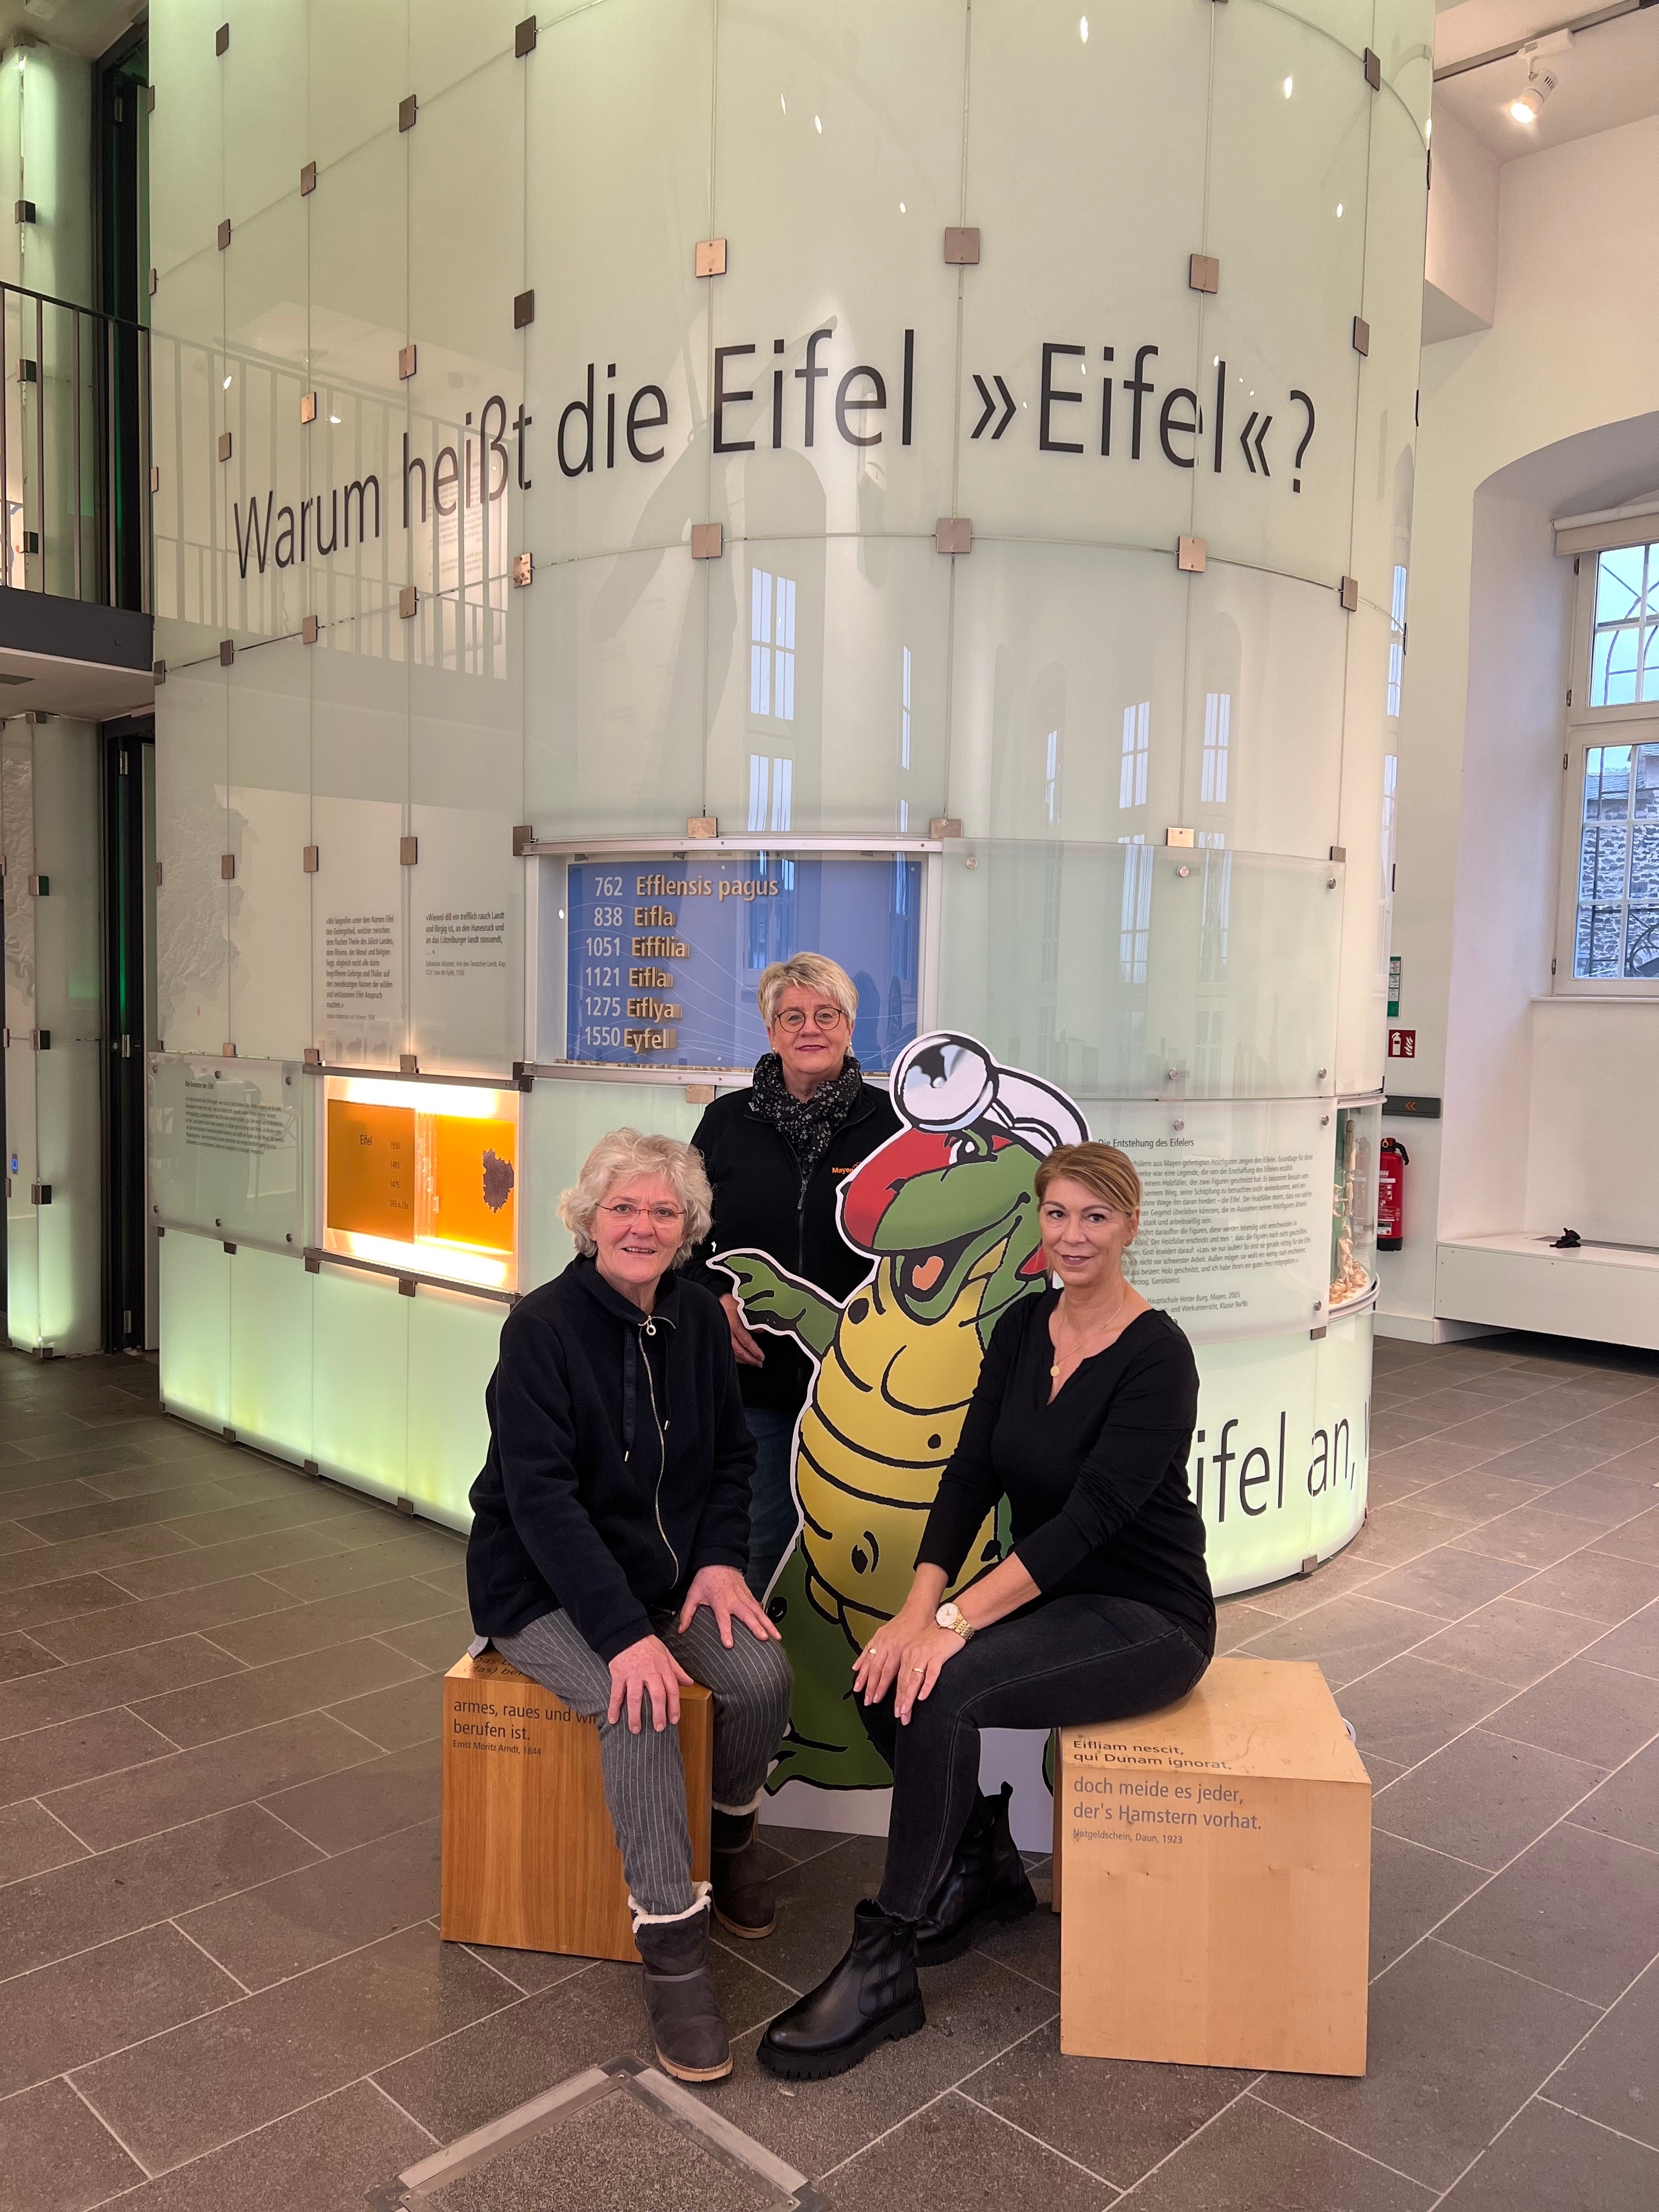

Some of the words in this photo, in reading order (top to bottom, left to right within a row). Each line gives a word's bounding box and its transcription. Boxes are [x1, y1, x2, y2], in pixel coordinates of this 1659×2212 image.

[234, 475, 379, 579] Warum
[403, 395, 532, 528] heißt
[557, 363, 668, 477] die
[713, 329, 914, 453] Eifel
[595, 876, 622, 896] 762
[636, 874, 712, 895] Efflensis
[719, 880, 778, 902] pagus
[492, 911, 504, 919] Landt
[594, 907, 623, 927] 838
[634, 905, 675, 926] Eifla
[425, 924, 434, 932] und
[461, 923, 470, 932] den
[467, 935, 479, 944] landt
[479, 935, 502, 945] stossendt,
[586, 937, 620, 957] 1051
[631, 936, 687, 957] Eiffilia
[586, 967, 619, 986] 1121
[629, 967, 669, 988] Eifla
[585, 997, 621, 1017] 1275
[627, 997, 676, 1023] Eiflya
[585, 1026, 620, 1046] 1550
[624, 1028, 670, 1054] Eyfel
[360, 1135, 372, 1146] Eifel
[1113, 1138, 1154, 1149] Entstehung
[1156, 1138, 1168, 1147] des
[1170, 1138, 1194, 1147] Eifelers
[1164, 1159, 1182, 1168] Mayen
[1183, 1158, 1210, 1167] gefertigten
[1211, 1157, 1238, 1166] Holzfiguren
[1239, 1156, 1254, 1165] zeigen
[1177, 1169, 1199, 1177] Legende,
[390, 1180, 399, 1189] 1475
[1163, 1178, 1188, 1187] Holzfäller,
[1212, 1177, 1229, 1186] Figuren
[1231, 1176, 1254, 1185] geschnitzt
[1165, 1189, 1178, 1197] Weg,
[1194, 1187, 1220, 1196] Schöpfung
[1157, 1199, 1172, 1207] Wege
[1150, 1209, 1171, 1217] Gegend
[1152, 1277, 1180, 1285] Gerolstein)
[1147, 1296, 1179, 1305] Hauptschule
[1197, 1294, 1209, 1303] Burg,
[1211, 1293, 1227, 1302] Mayen,
[1229, 1291, 1240, 1299] 2005
[1182, 1303, 1218, 1313] Werkunterricht,
[1235, 1300, 1248, 1308] 9a/9b
[1196, 1410, 1286, 1523] ifel
[1307, 1418, 1355, 1497] an,
[454, 1701, 498, 1717] armes,
[503, 1705, 540, 1719] raues
[545, 1707, 571, 1722] und
[454, 1719, 506, 1738] berufen
[511, 1725, 531, 1740] ist.
[453, 1740, 471, 1748] Ernst
[473, 1742, 496, 1751] Moritz
[498, 1744, 521, 1754] Arndt,
[523, 1746, 541, 1755] 1844
[1074, 1741, 1127, 1751] Eifliam
[1133, 1743, 1184, 1755] nescit,
[1074, 1753, 1098, 1762] qui
[1104, 1753, 1163, 1765] Dunam
[1168, 1757, 1232, 1770] ignorat,
[1074, 1776, 1113, 1795] doch
[1119, 1780, 1169, 1798] meide
[1175, 1787, 1192, 1799] es
[1197, 1784, 1243, 1805] jeder,
[1074, 1802, 1113, 1820] der's
[1119, 1805, 1197, 1825] Hamstern
[1203, 1812, 1262, 1830] vorhat.
[1073, 1829, 1132, 1842] Notgeldschein,
[1136, 1833, 1159, 1843] Daun,
[1163, 1835, 1183, 1844] 1923
